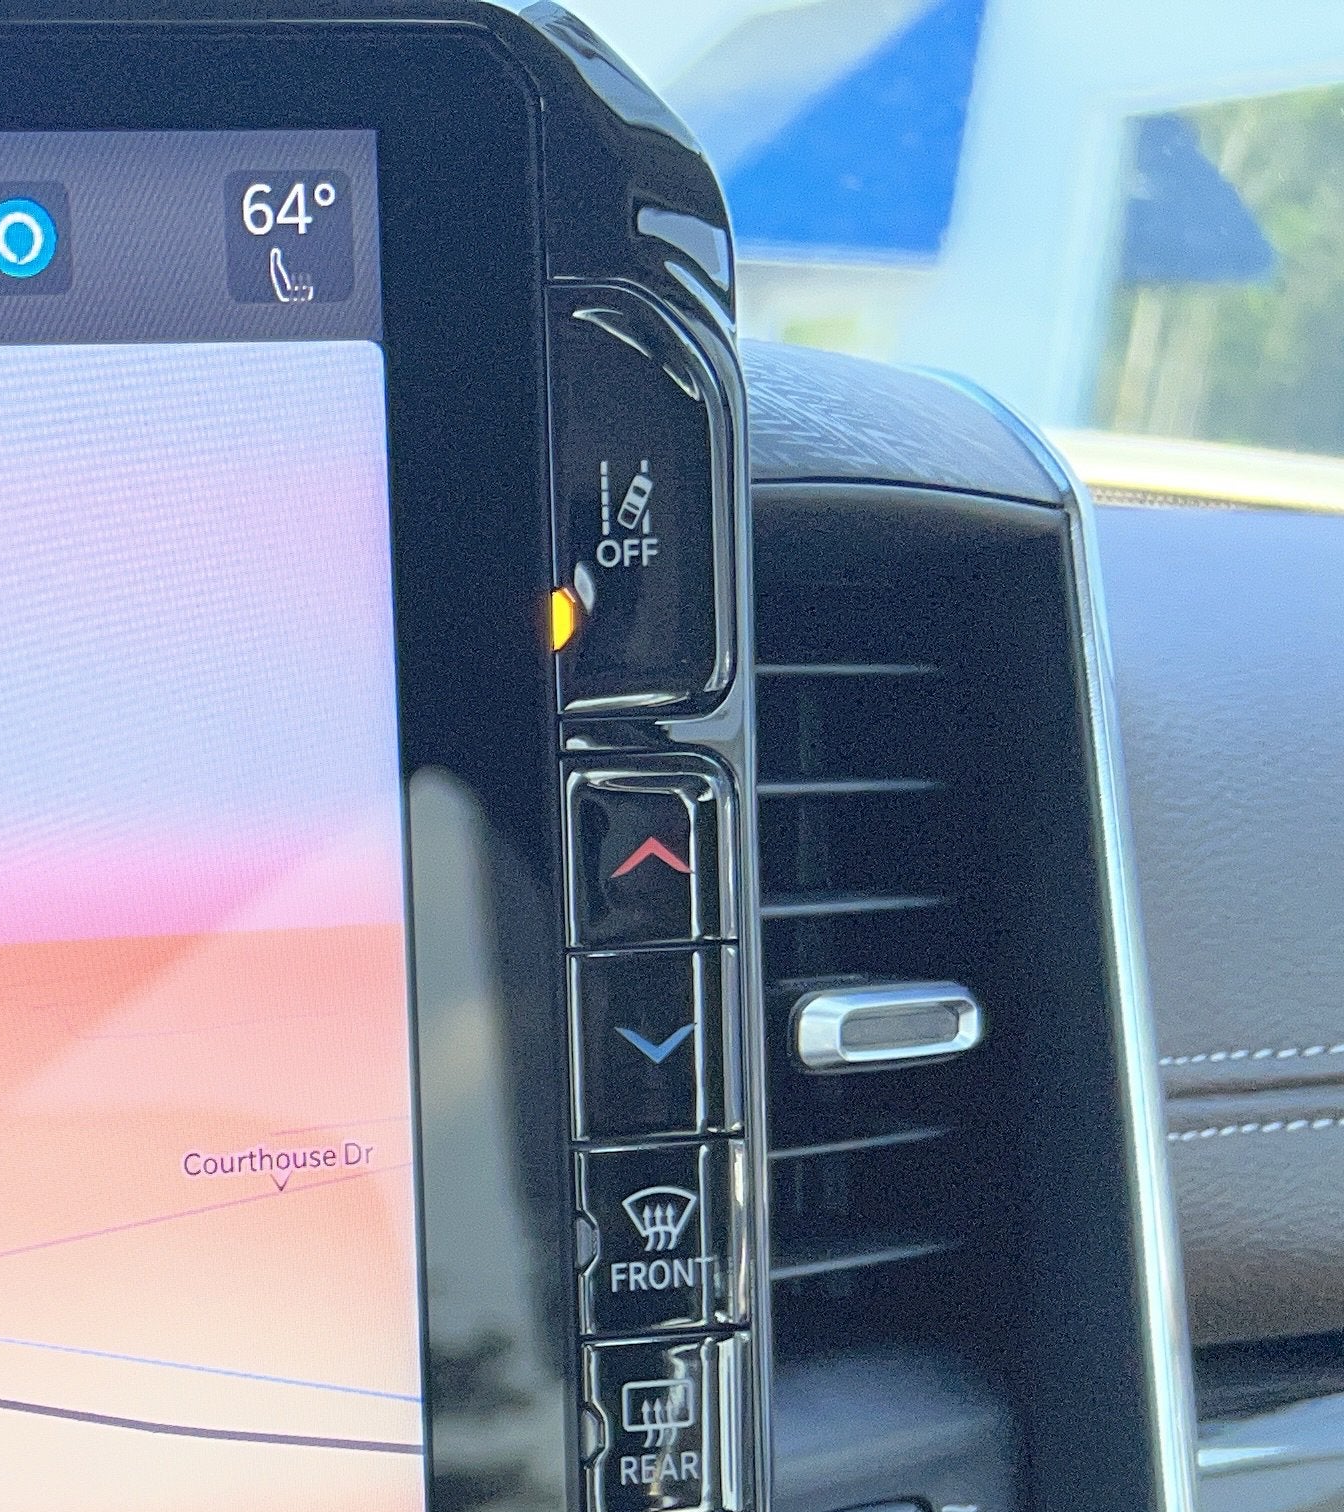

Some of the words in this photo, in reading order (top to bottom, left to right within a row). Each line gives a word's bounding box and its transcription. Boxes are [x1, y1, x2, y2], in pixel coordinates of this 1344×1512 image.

[596, 537, 658, 568] OFF
[183, 1142, 336, 1178] Courthouse
[343, 1140, 374, 1166] Dr
[611, 1256, 717, 1293] FRONT
[620, 1451, 701, 1486] REAR
